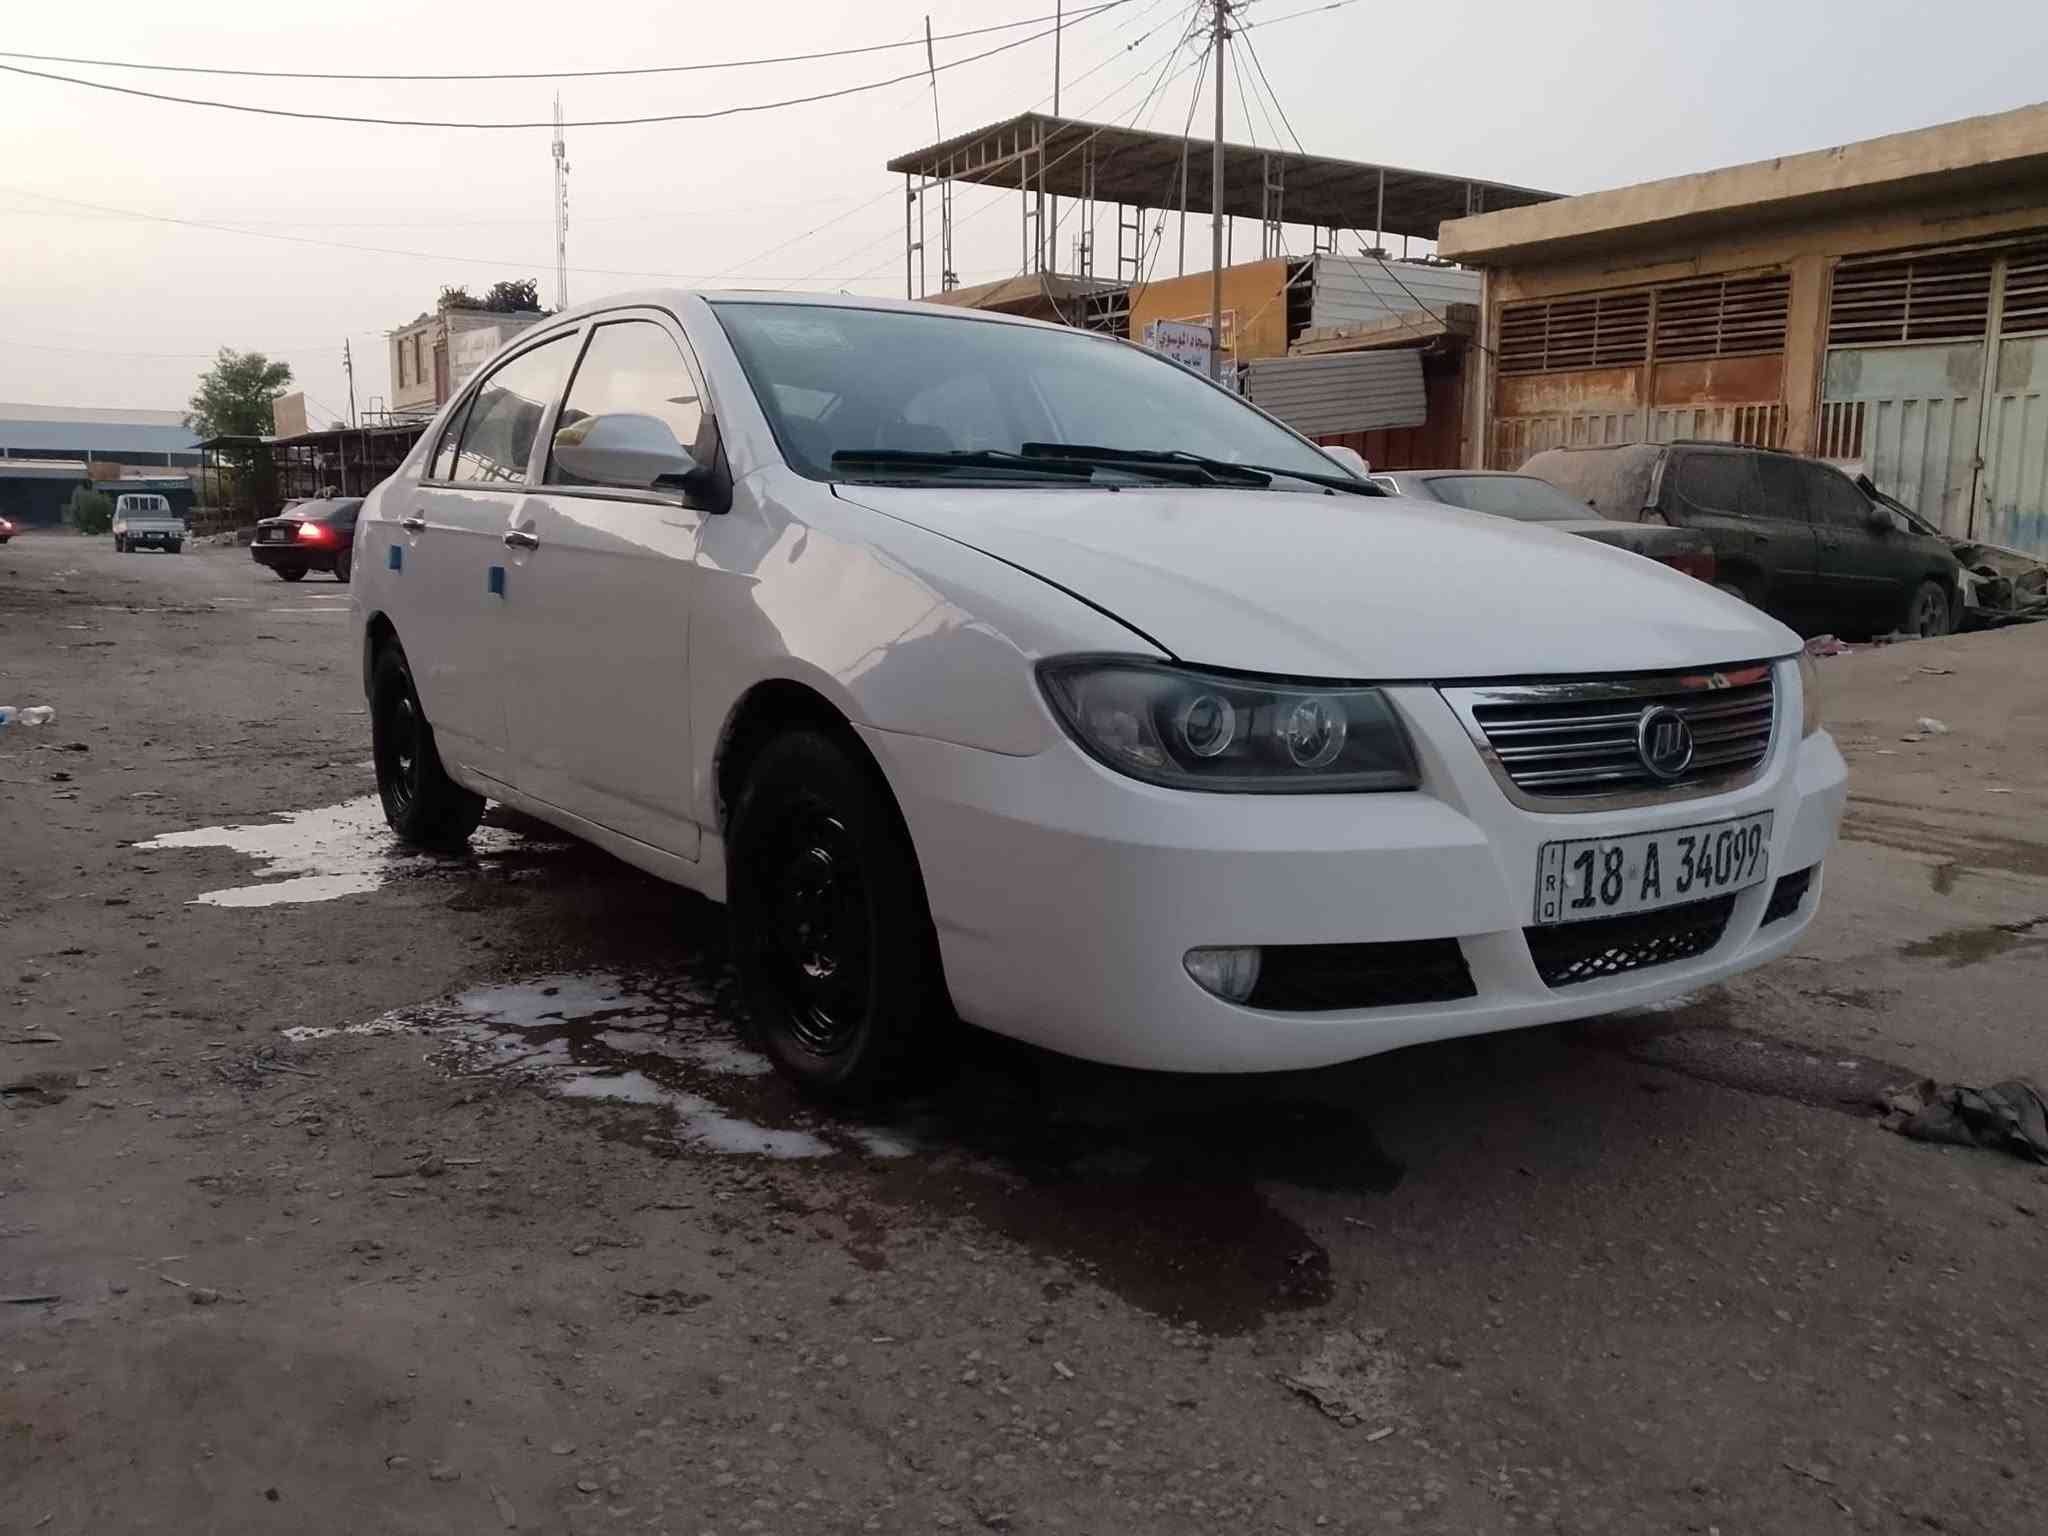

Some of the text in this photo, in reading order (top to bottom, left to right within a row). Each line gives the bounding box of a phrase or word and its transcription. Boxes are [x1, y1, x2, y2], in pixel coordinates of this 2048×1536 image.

[1571, 824, 1762, 908] 18 A 34099
